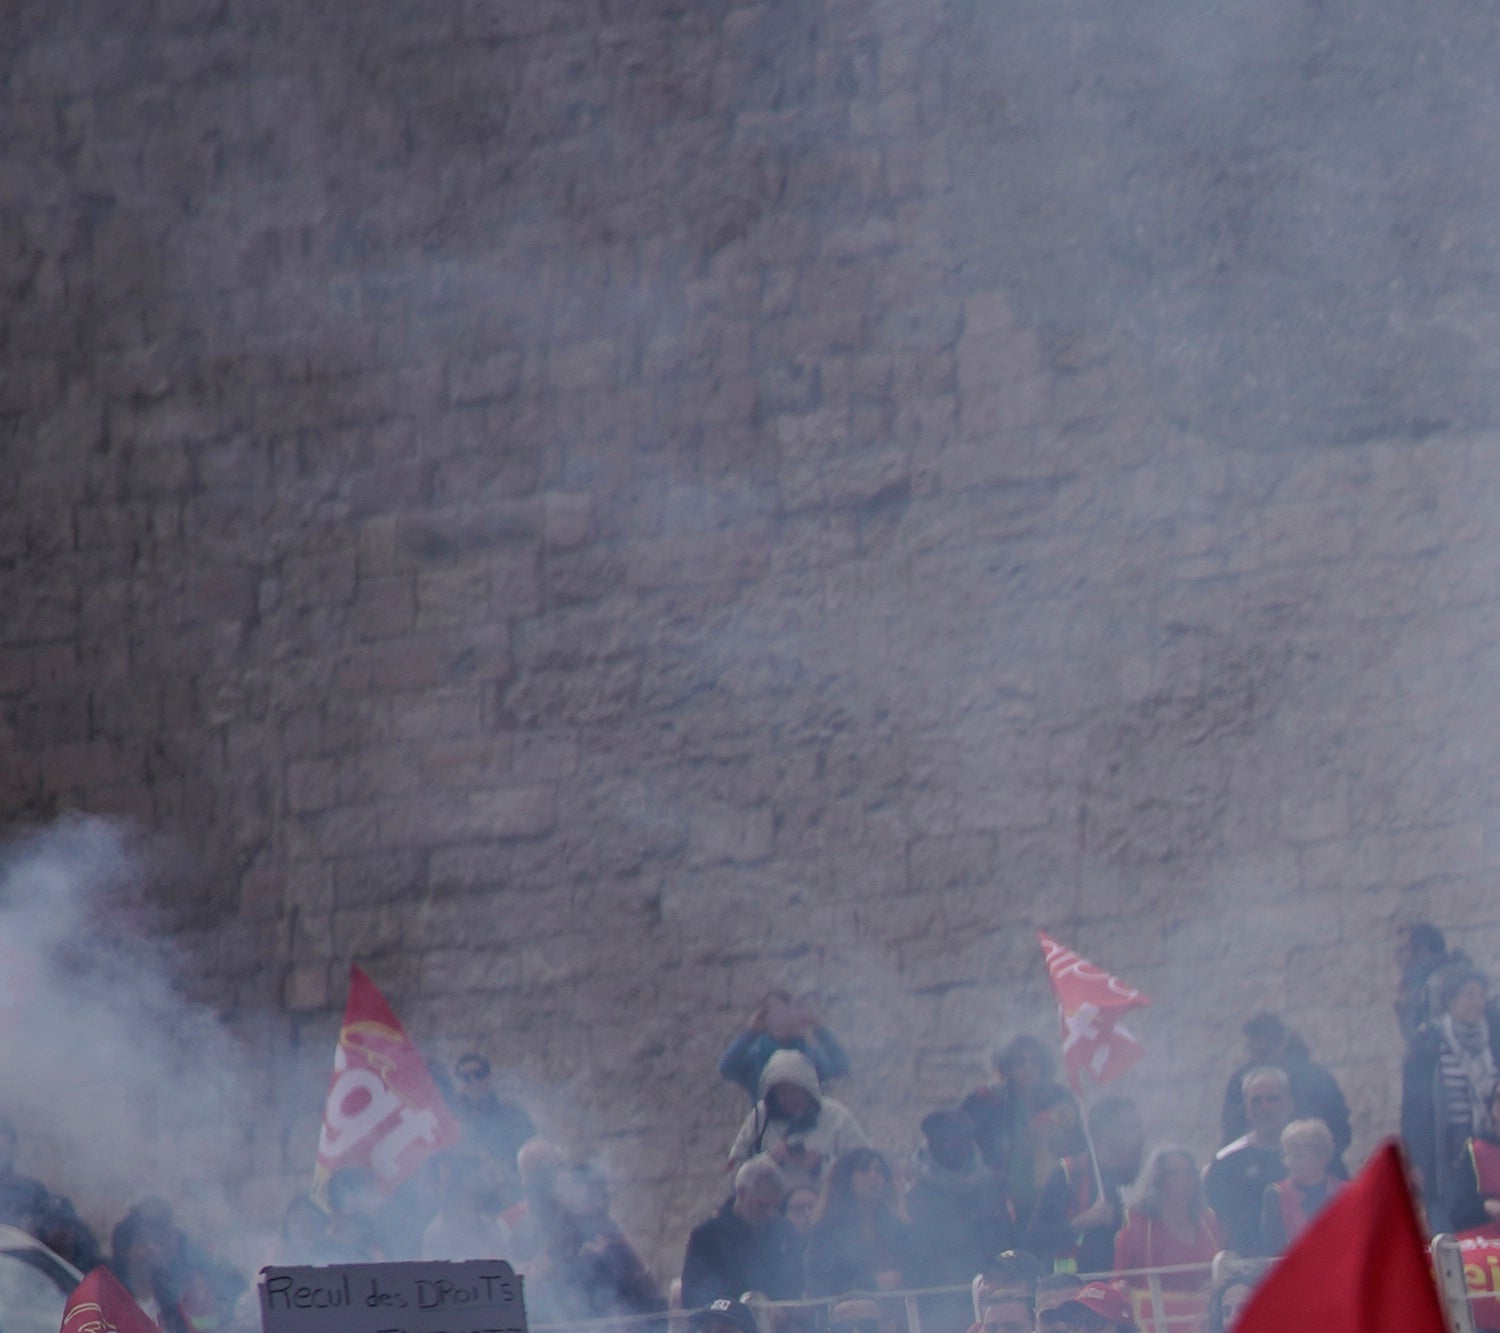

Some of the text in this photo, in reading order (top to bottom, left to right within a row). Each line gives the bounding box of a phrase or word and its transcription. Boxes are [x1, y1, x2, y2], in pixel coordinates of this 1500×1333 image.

[318, 1042, 440, 1177] gt
[267, 1274, 352, 1310] Recul
[365, 1277, 410, 1309] des
